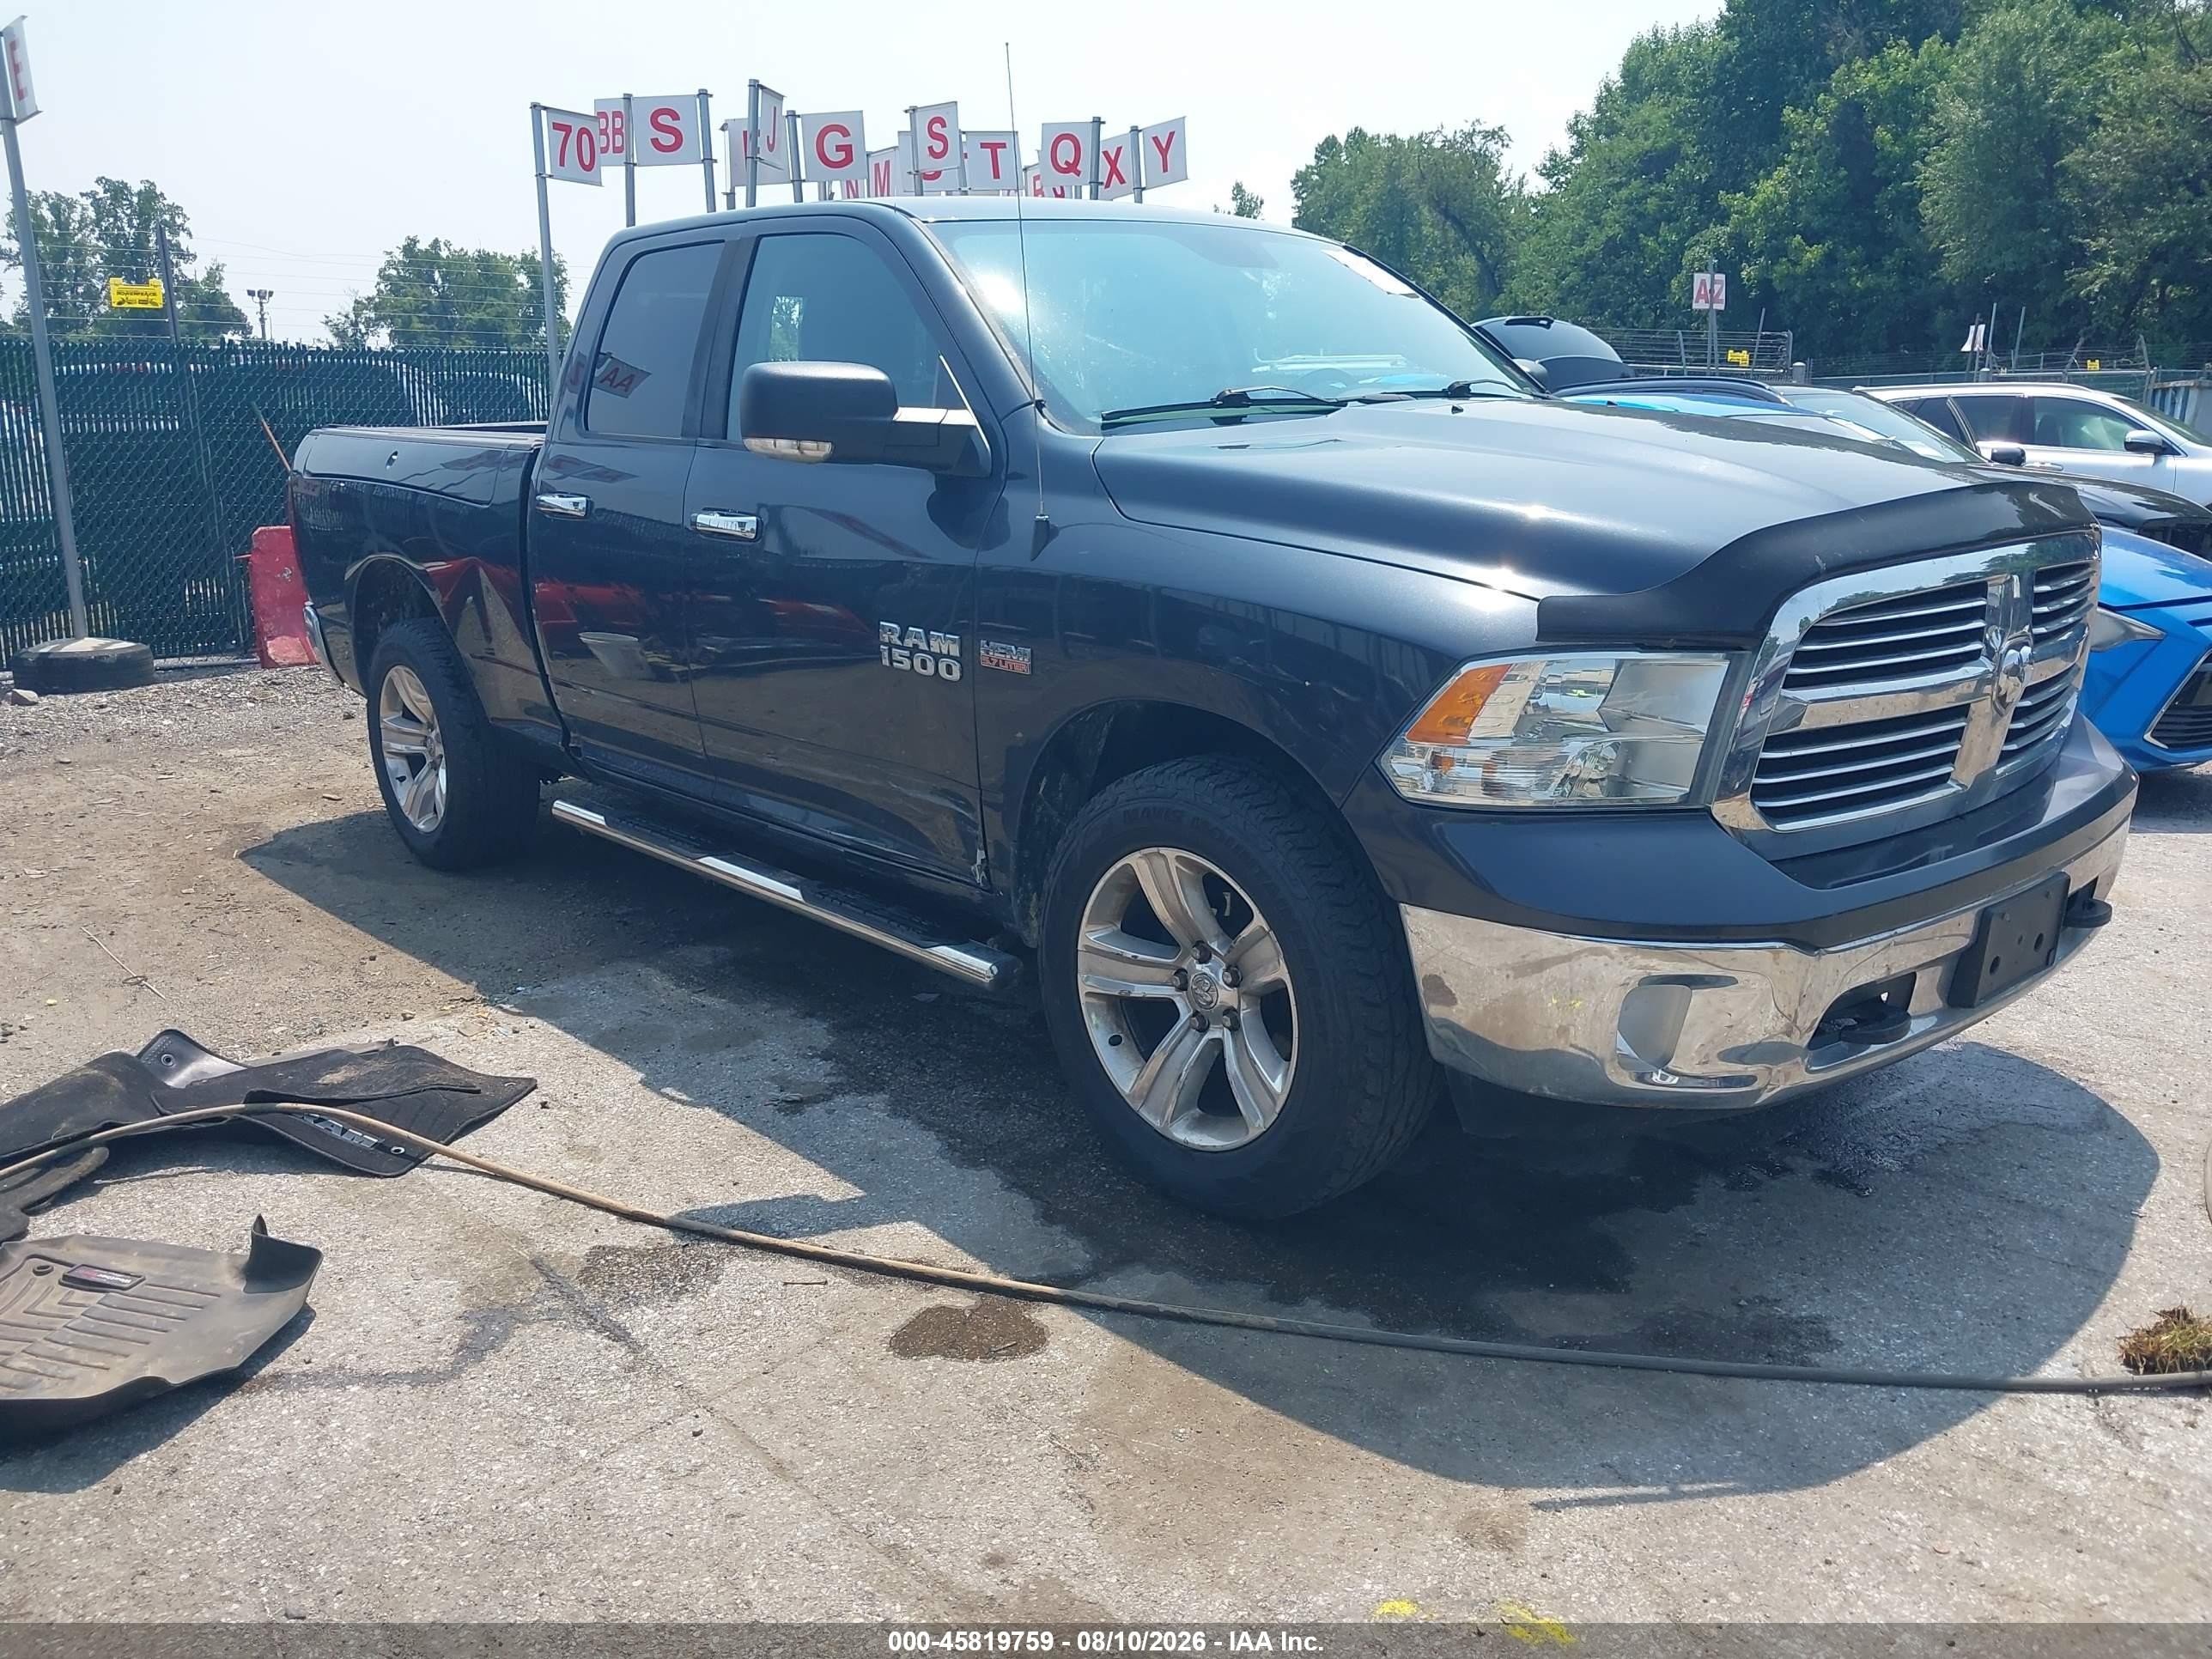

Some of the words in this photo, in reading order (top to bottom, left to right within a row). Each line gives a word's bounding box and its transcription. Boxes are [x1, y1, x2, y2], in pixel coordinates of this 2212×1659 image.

[551, 121, 596, 172] 70
[649, 107, 684, 153] S
[767, 106, 777, 153] J
[816, 124, 854, 169] G
[927, 116, 949, 159] S
[980, 142, 1006, 179] T
[1049, 133, 1082, 177] Q
[1102, 146, 1127, 189] X
[1152, 131, 1176, 173] Y
[873, 160, 890, 198] M
[879, 621, 960, 658] RAM
[980, 639, 1031, 662] HEMI
[879, 645, 963, 682] 1500
[981, 655, 998, 667] 5.7
